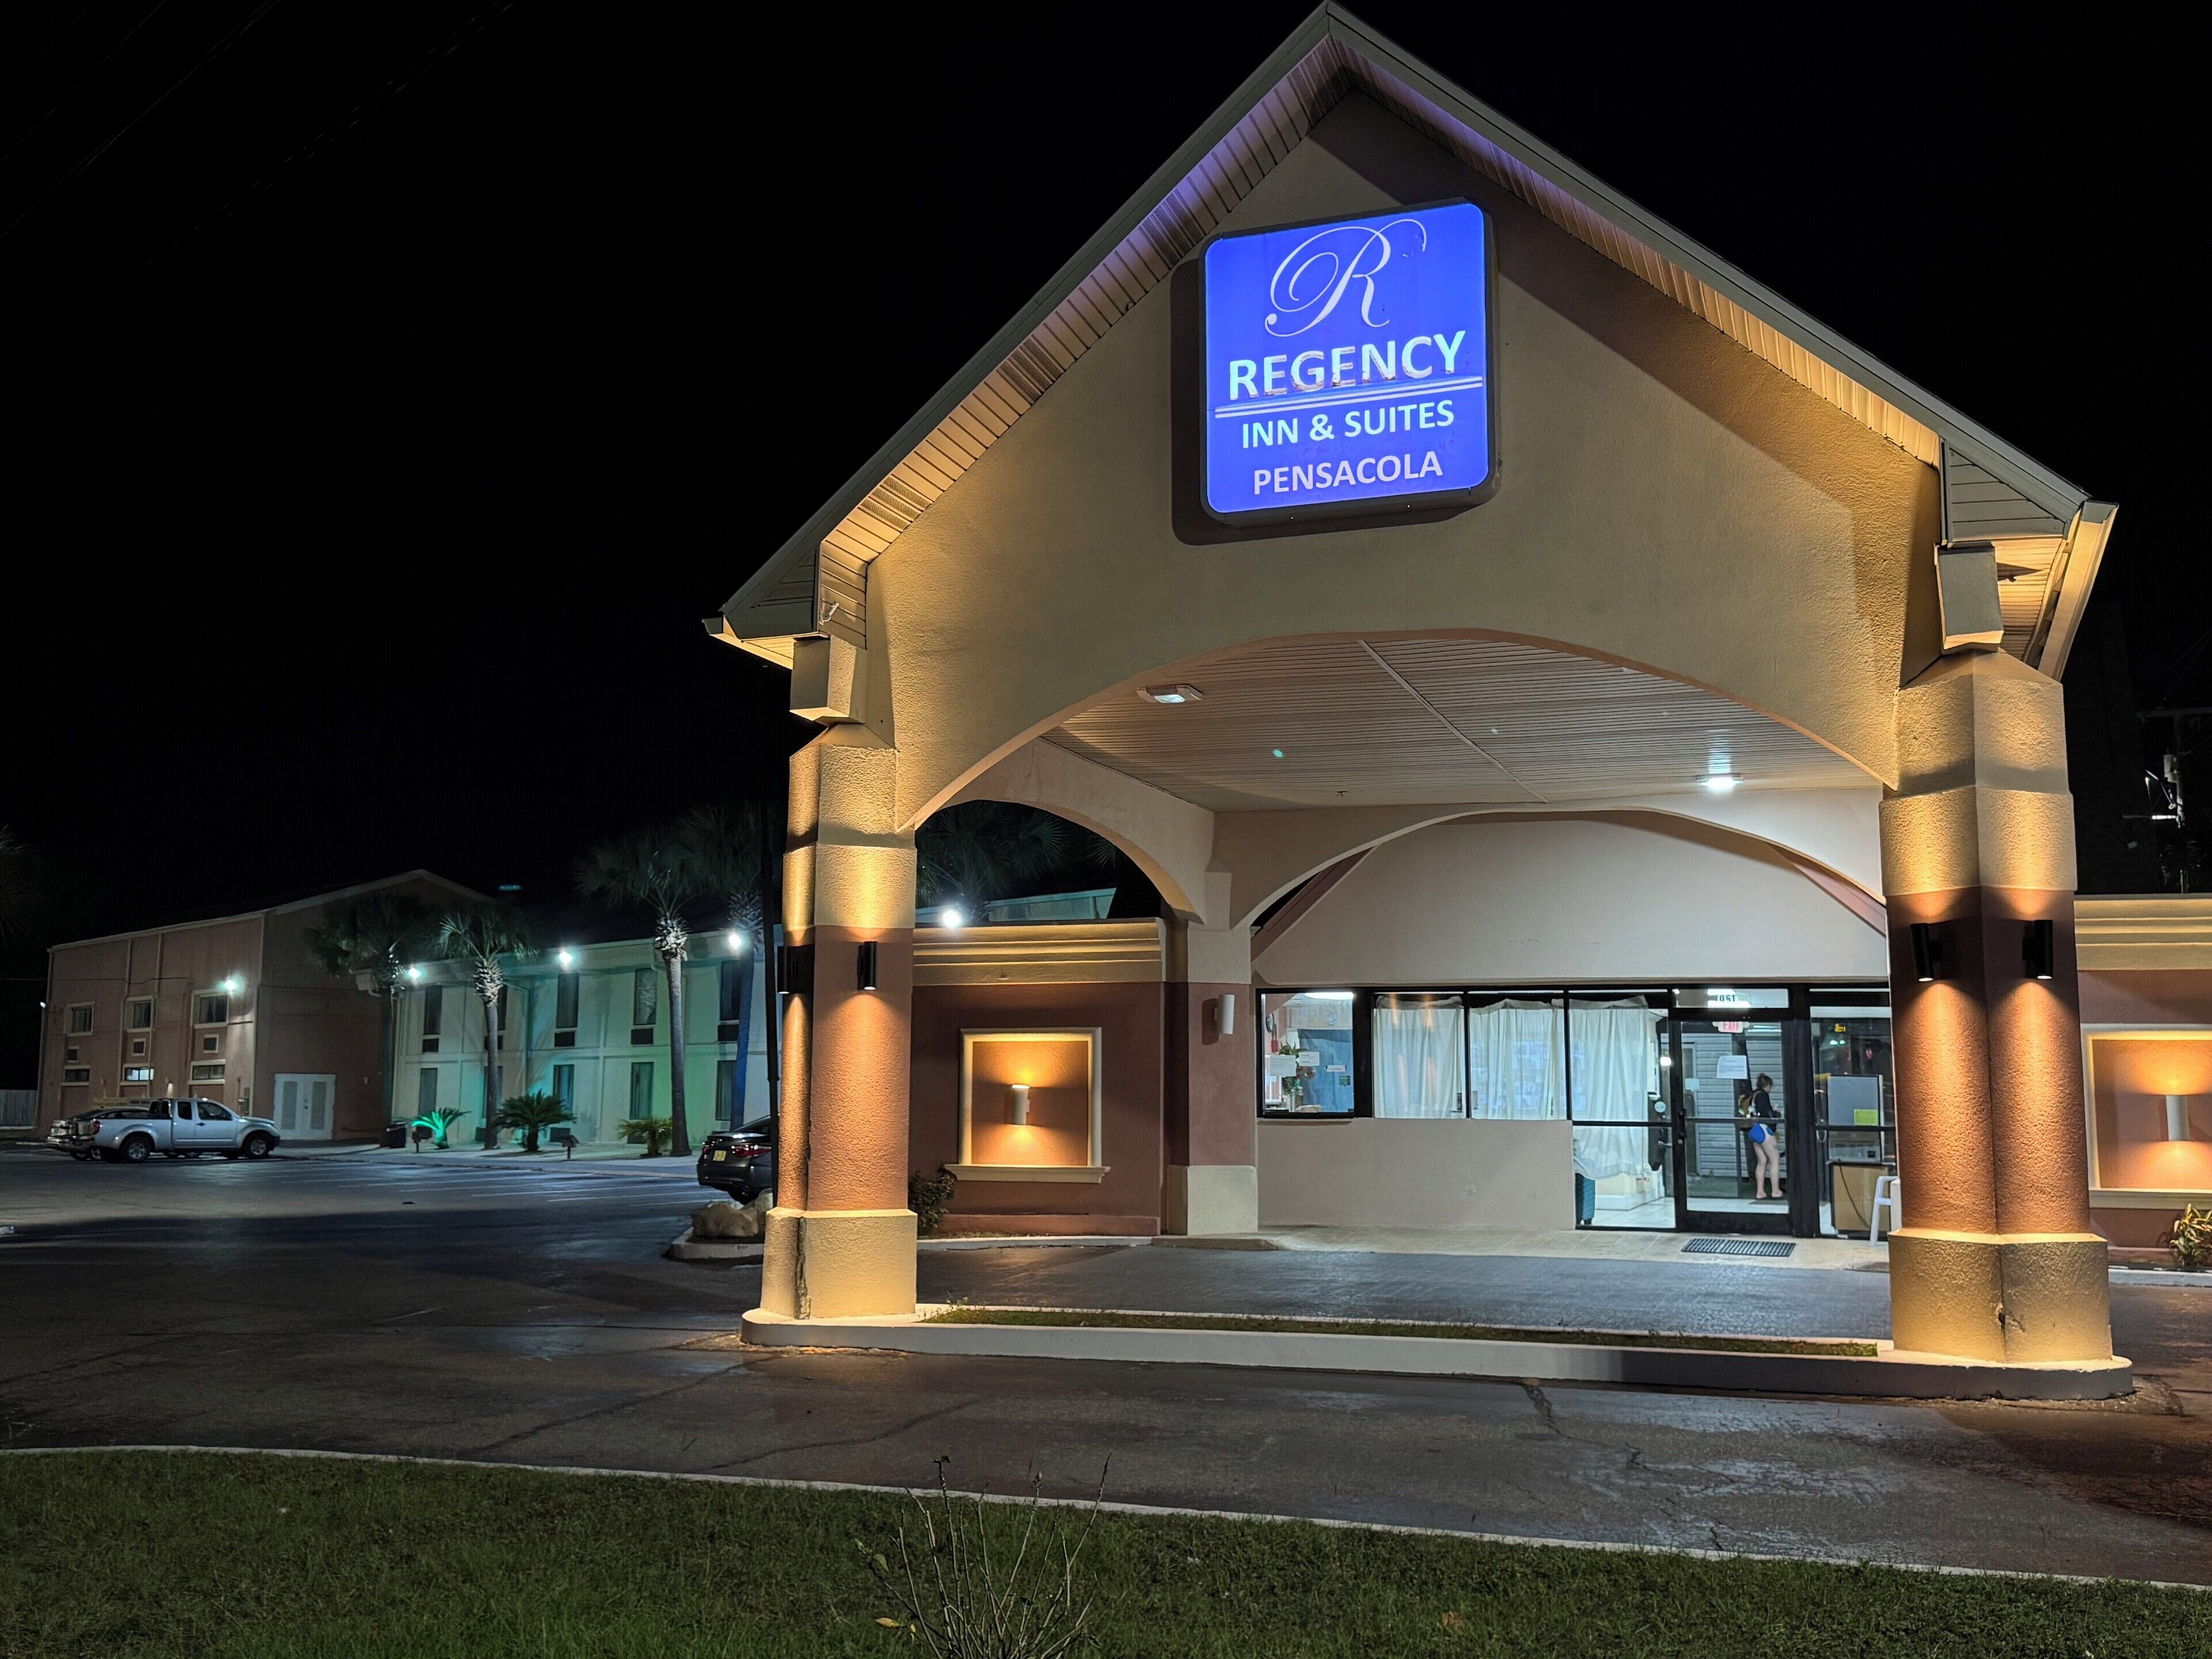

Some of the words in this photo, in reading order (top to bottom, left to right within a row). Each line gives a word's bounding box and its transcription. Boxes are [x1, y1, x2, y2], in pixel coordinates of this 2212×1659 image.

[1264, 219, 1427, 337] R
[1229, 330, 1466, 400] REGENCY
[1242, 418, 1298, 449] INN
[1309, 414, 1335, 441] &
[1344, 399, 1455, 437] SUITES
[1253, 451, 1443, 495] PENSACOLA
